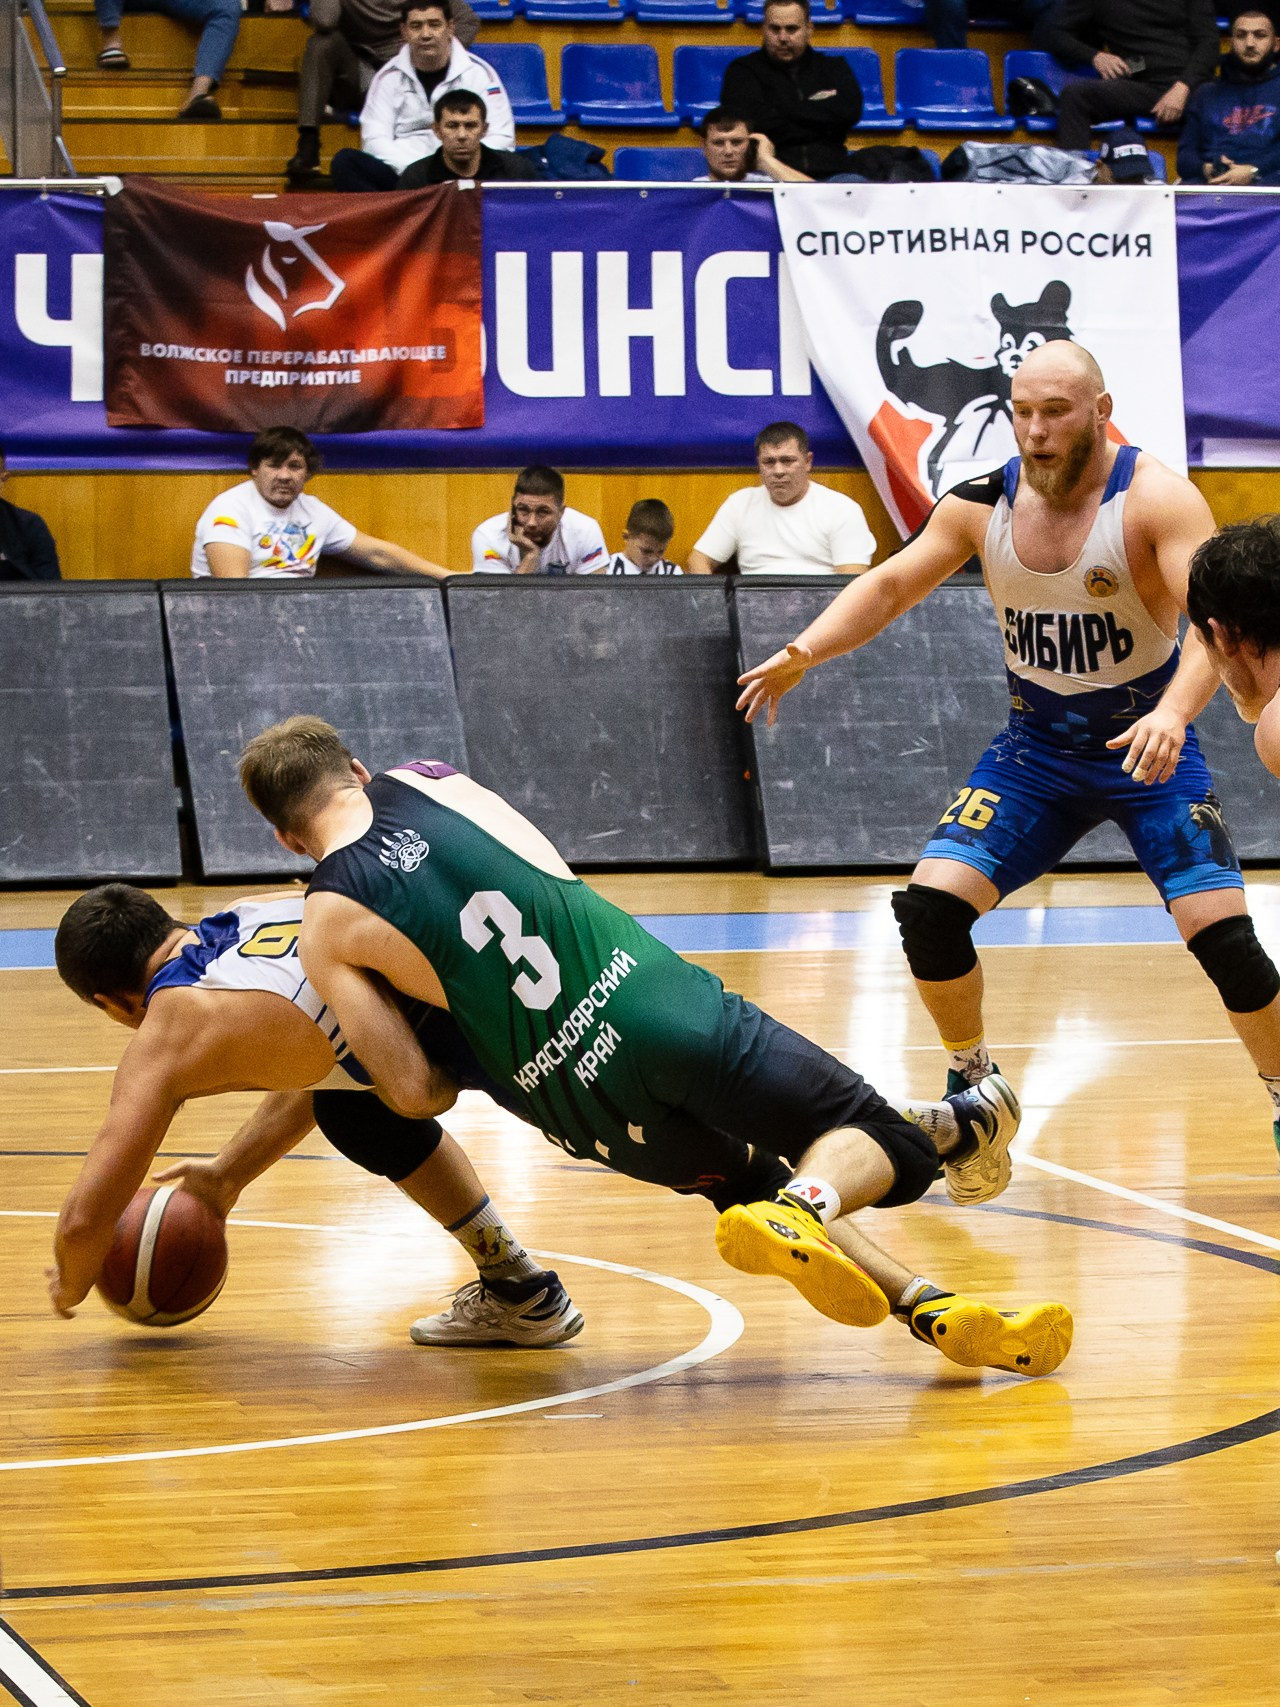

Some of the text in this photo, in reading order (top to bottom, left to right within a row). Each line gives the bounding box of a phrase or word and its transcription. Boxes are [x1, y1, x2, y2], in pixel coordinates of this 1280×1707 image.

[797, 227, 1153, 258] СПОРТИВНАЯ РОССИЯ
[140, 343, 448, 364] ВОЛЖСКОЕ ПЕРЕРАБАТЫВАЮЩЕЕ
[225, 369, 362, 388] ПРЕДПРИЯТИЕ
[938, 786, 1002, 830] 26
[459, 889, 563, 1011] 3
[512, 946, 639, 1094] КРАСНОЯРСКИЙ
[573, 1020, 623, 1089] КРАЙ
